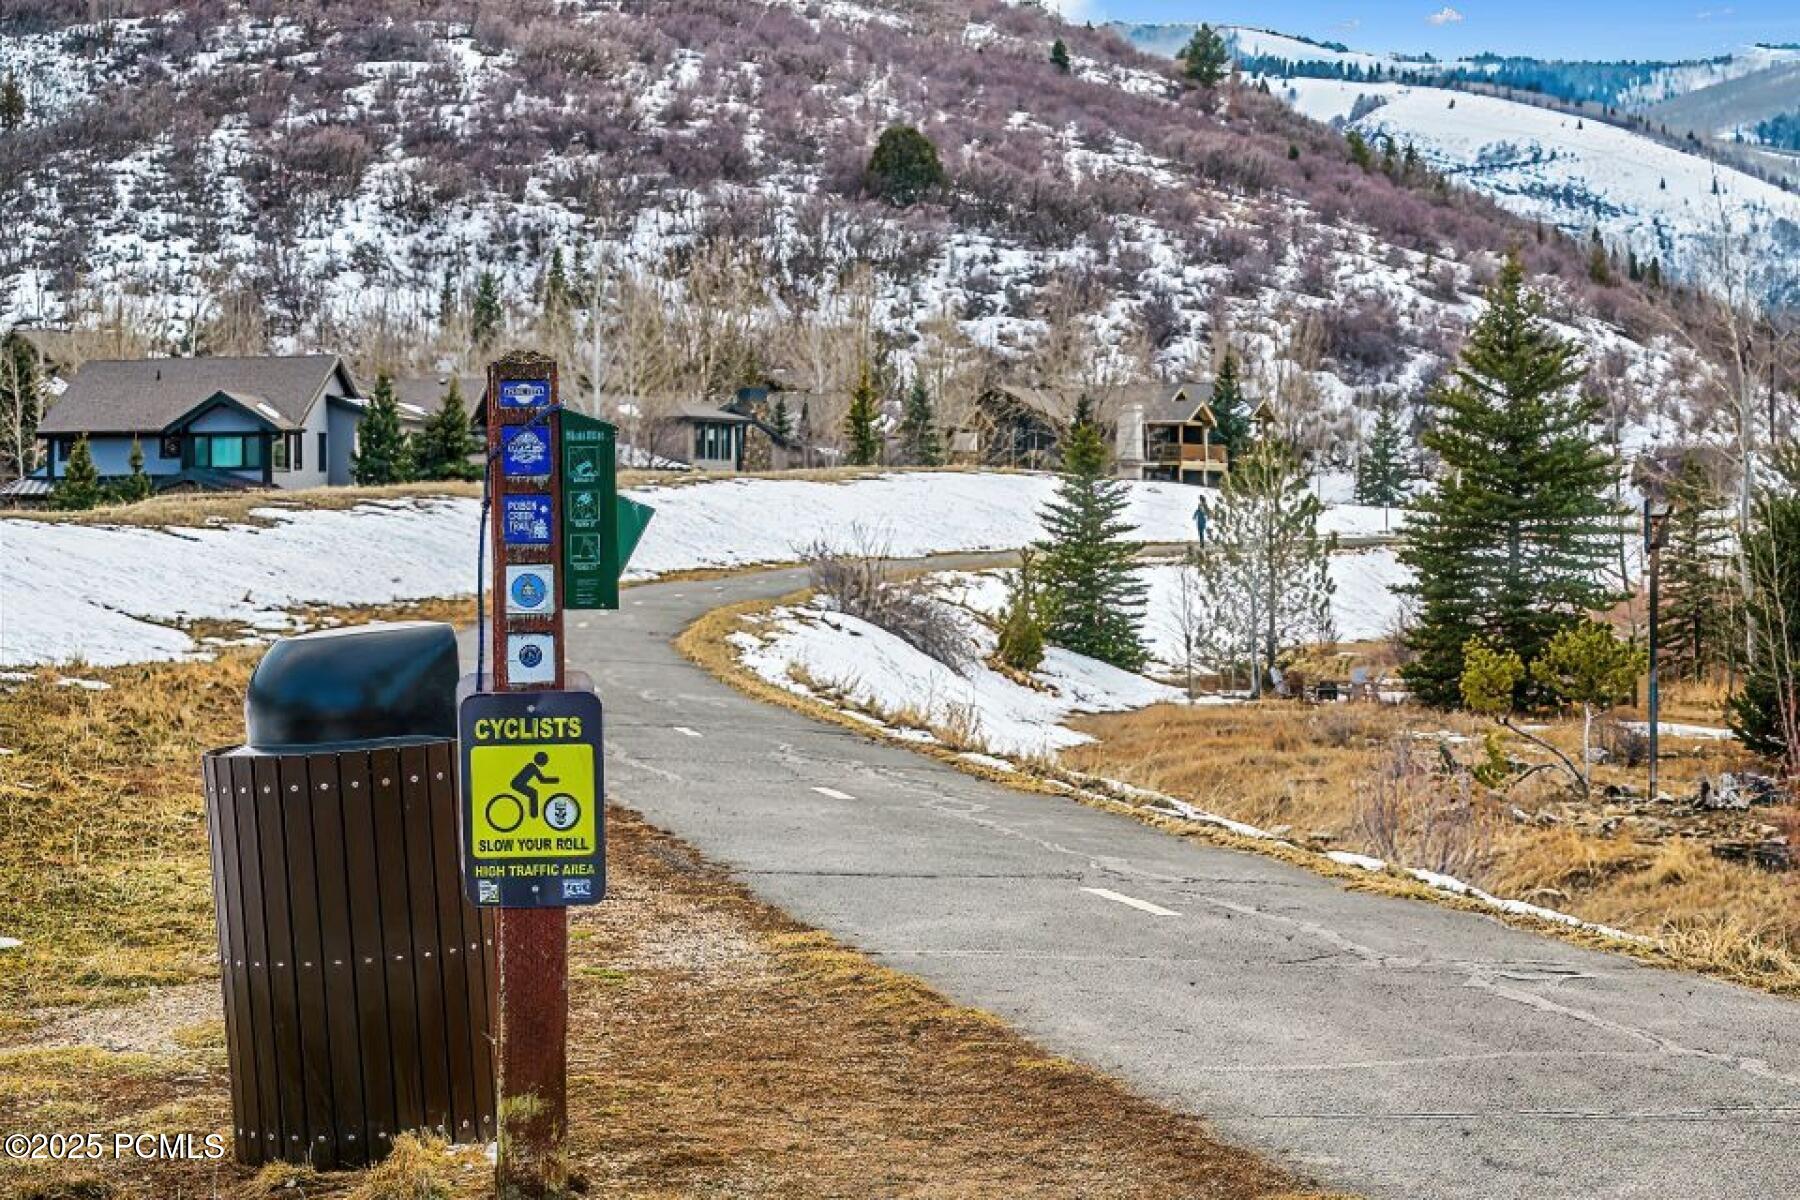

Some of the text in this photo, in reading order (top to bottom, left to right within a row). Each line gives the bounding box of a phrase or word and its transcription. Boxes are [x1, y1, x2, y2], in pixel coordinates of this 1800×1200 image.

[475, 717, 582, 739] CYCLISTS
[479, 837, 589, 852] SLOW YOUR ROLL
[475, 863, 595, 878] HIGH TRAFFIC AREA
